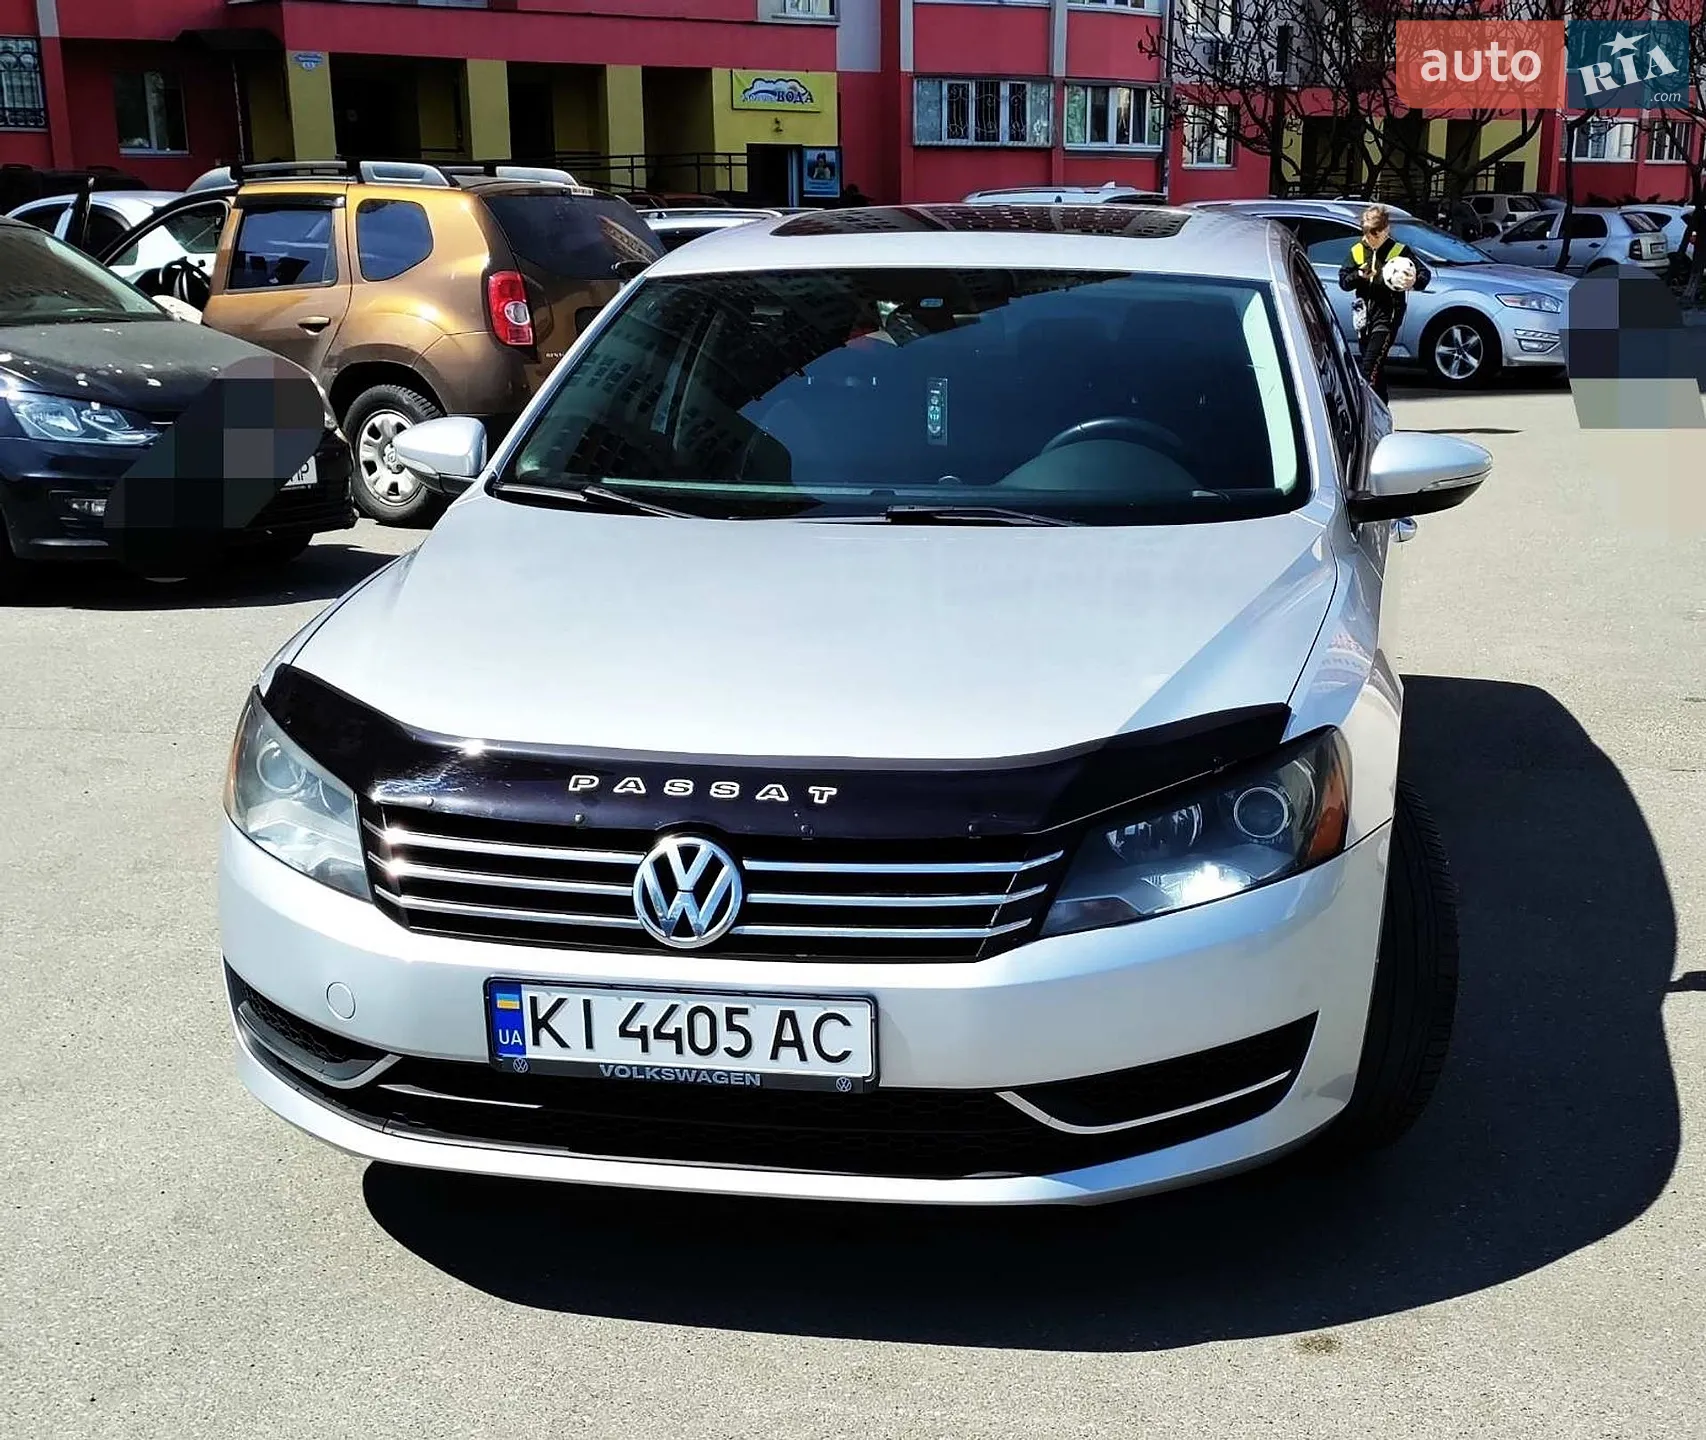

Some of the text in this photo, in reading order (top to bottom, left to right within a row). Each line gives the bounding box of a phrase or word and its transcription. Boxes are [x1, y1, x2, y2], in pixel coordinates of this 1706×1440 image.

[776, 91, 814, 104] ВОДА
[567, 774, 838, 804] PASSAT
[498, 1028, 523, 1046] UA
[528, 995, 854, 1064] KI 4405 AC
[599, 1063, 761, 1087] VOLKSWAGEN
